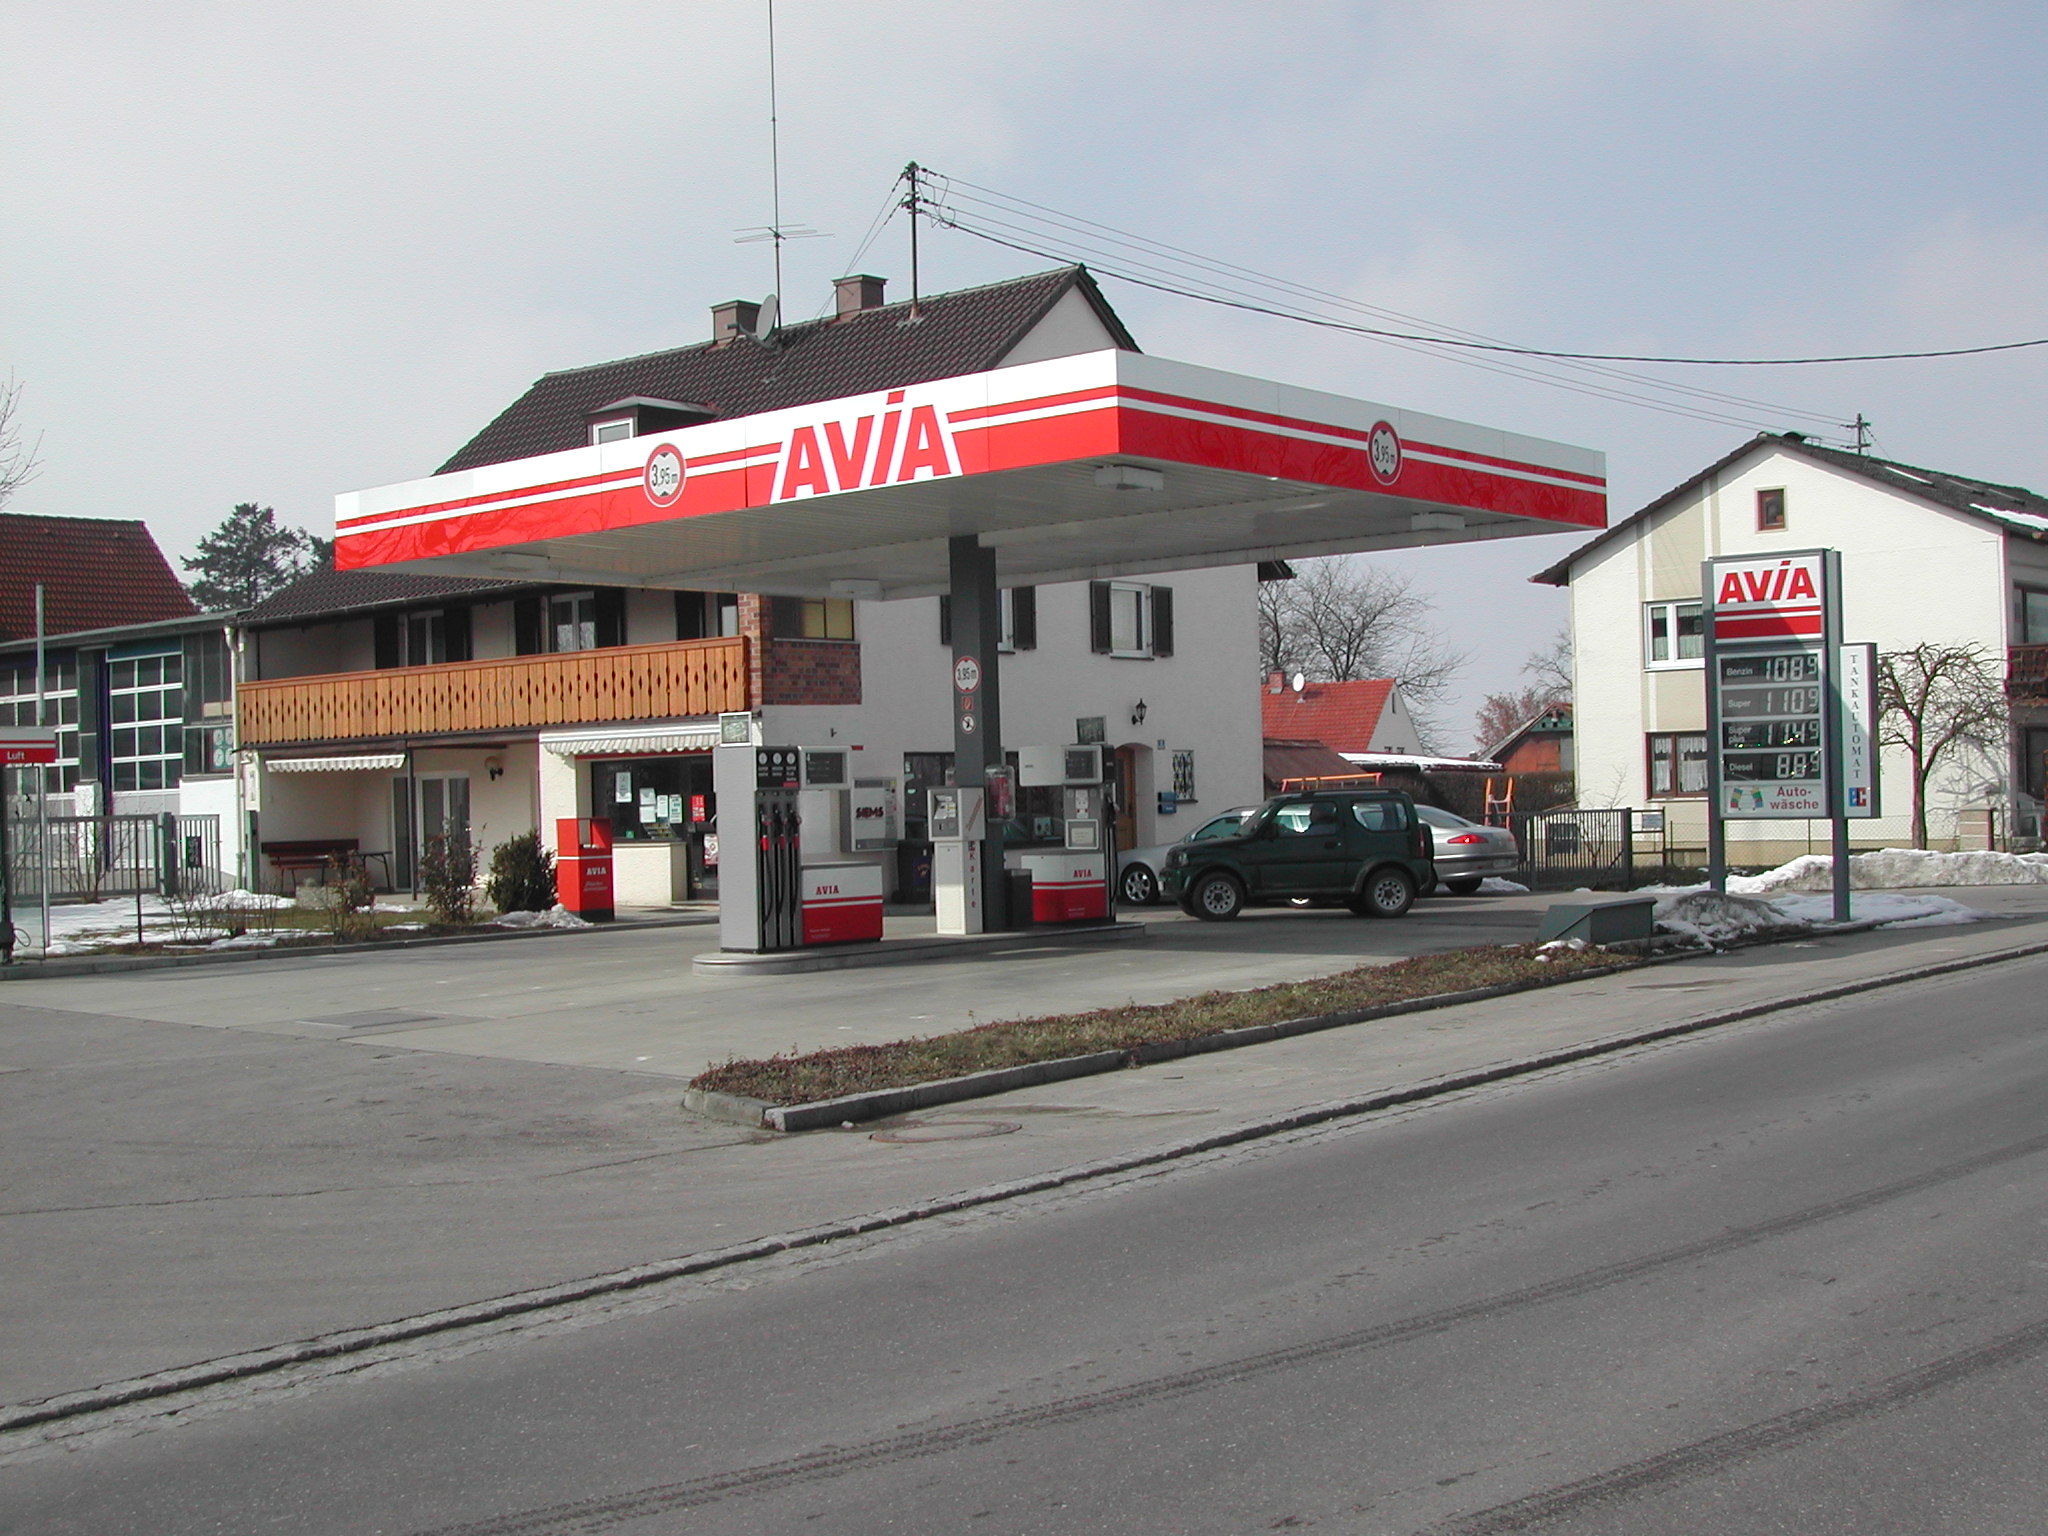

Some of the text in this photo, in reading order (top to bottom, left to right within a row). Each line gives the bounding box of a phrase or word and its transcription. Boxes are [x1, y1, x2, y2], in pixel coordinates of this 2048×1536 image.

[780, 389, 952, 500] AVIA
[1718, 560, 1817, 604] AVIA
[1726, 667, 1753, 676] Benzin
[1728, 699, 1751, 709] Super
[1850, 654, 1861, 779] TANKAUTOMAT
[1728, 726, 1752, 736] Super
[7, 751, 25, 760] Luft
[1729, 762, 1753, 772] Diesel
[1777, 786, 1812, 797] Auto-
[1770, 799, 1819, 810] wäsche
[586, 867, 607, 876] AVIA
[1073, 869, 1092, 878] AVIA
[816, 885, 839, 895] AVIA
